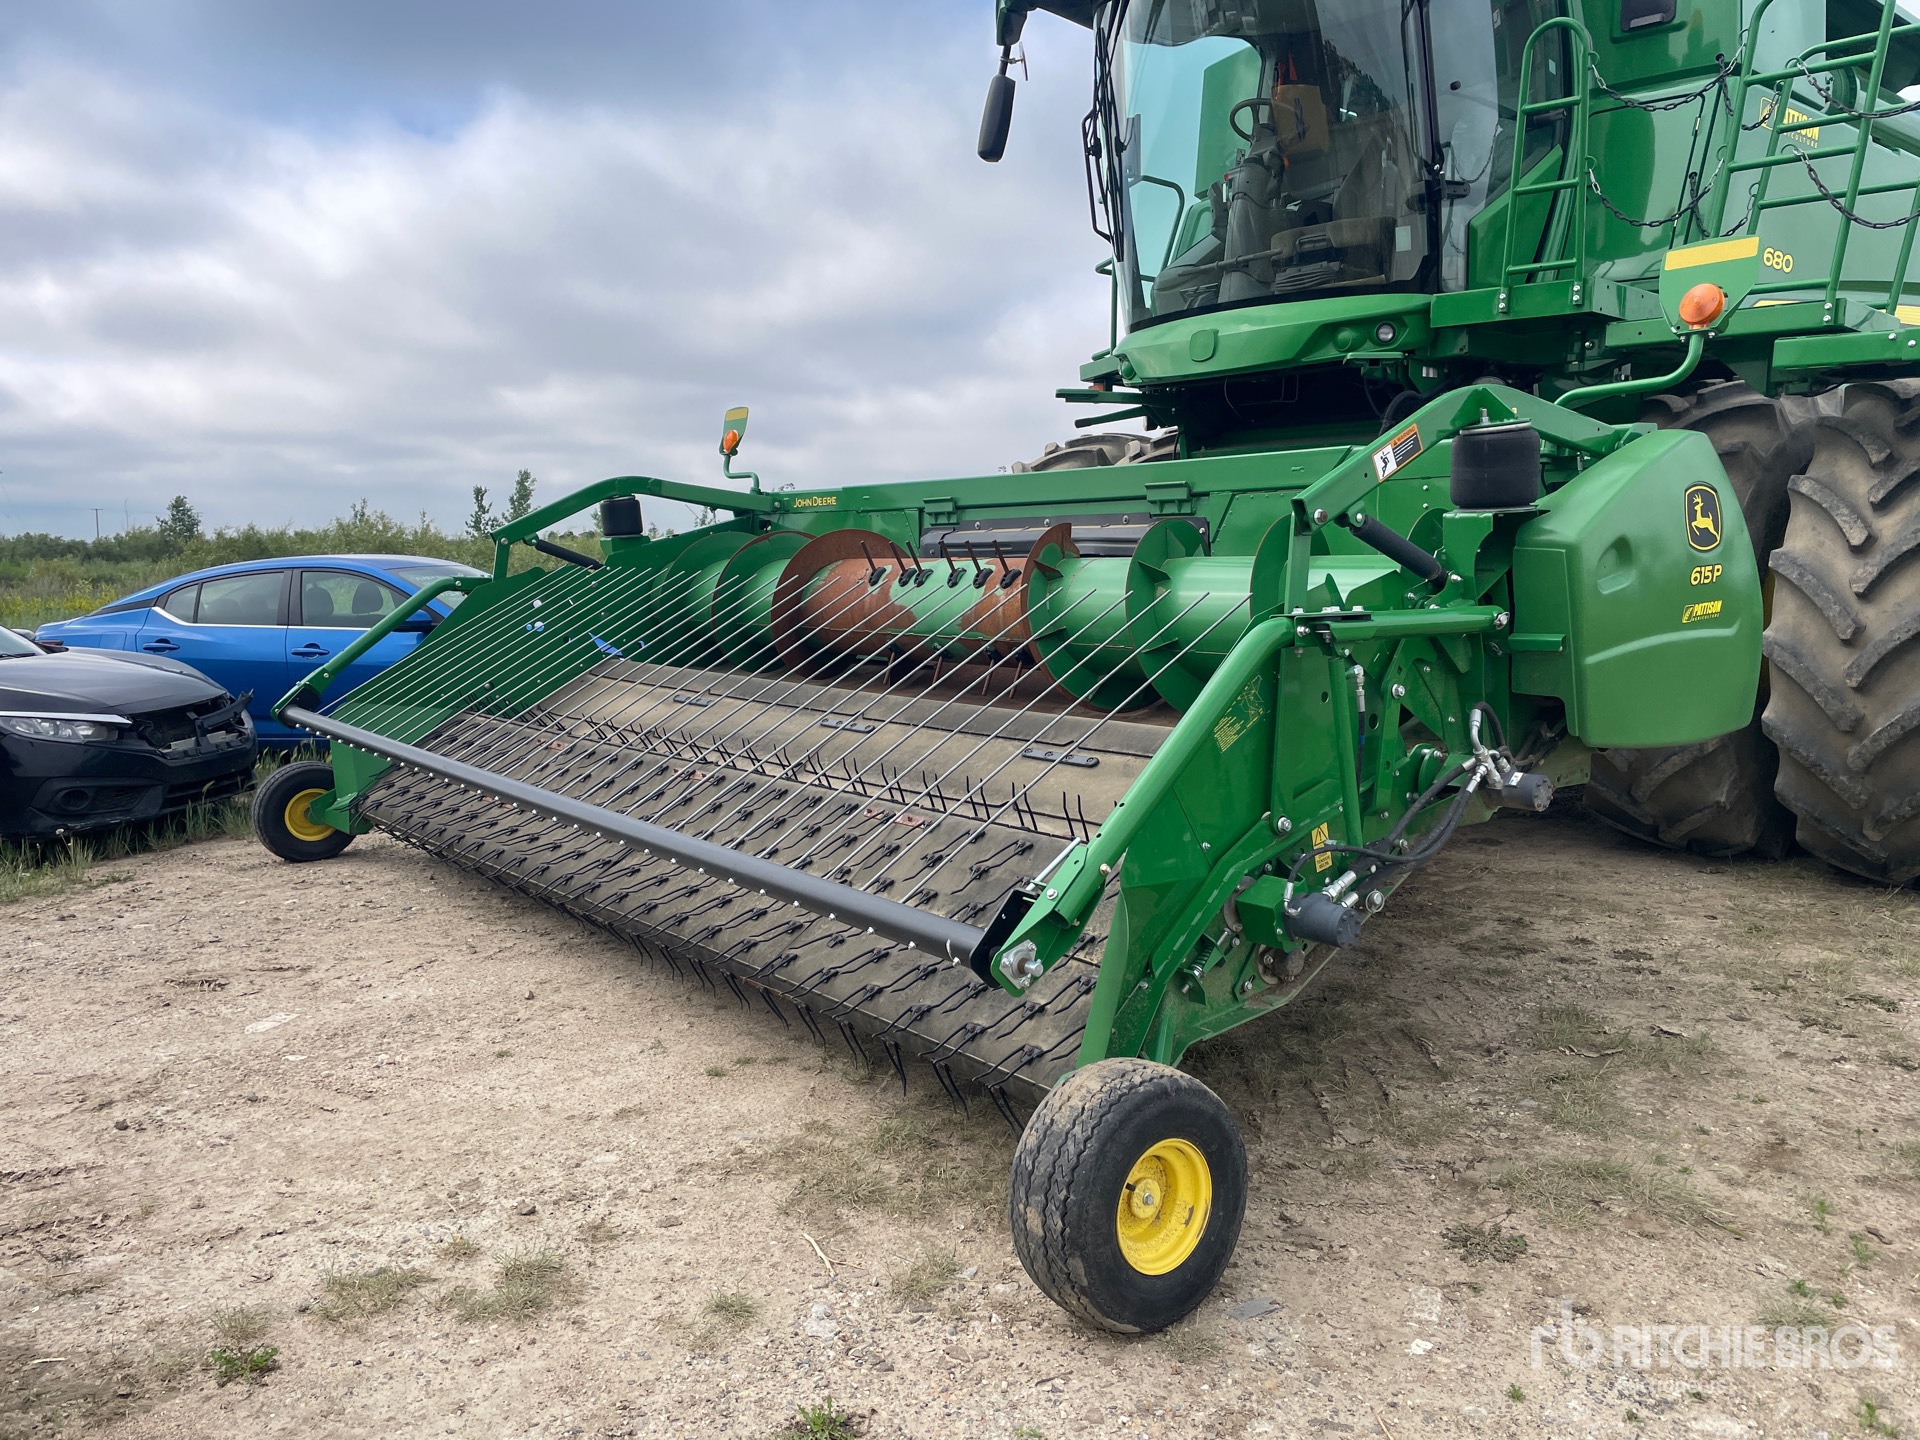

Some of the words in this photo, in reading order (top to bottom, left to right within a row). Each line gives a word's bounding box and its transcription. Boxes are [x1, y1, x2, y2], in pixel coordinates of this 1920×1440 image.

[1763, 247, 1794, 273] 680
[794, 497, 812, 508] JOHN
[812, 496, 837, 507] DEERE
[1690, 564, 1723, 586] 615P
[1693, 600, 1723, 617] PATTISON
